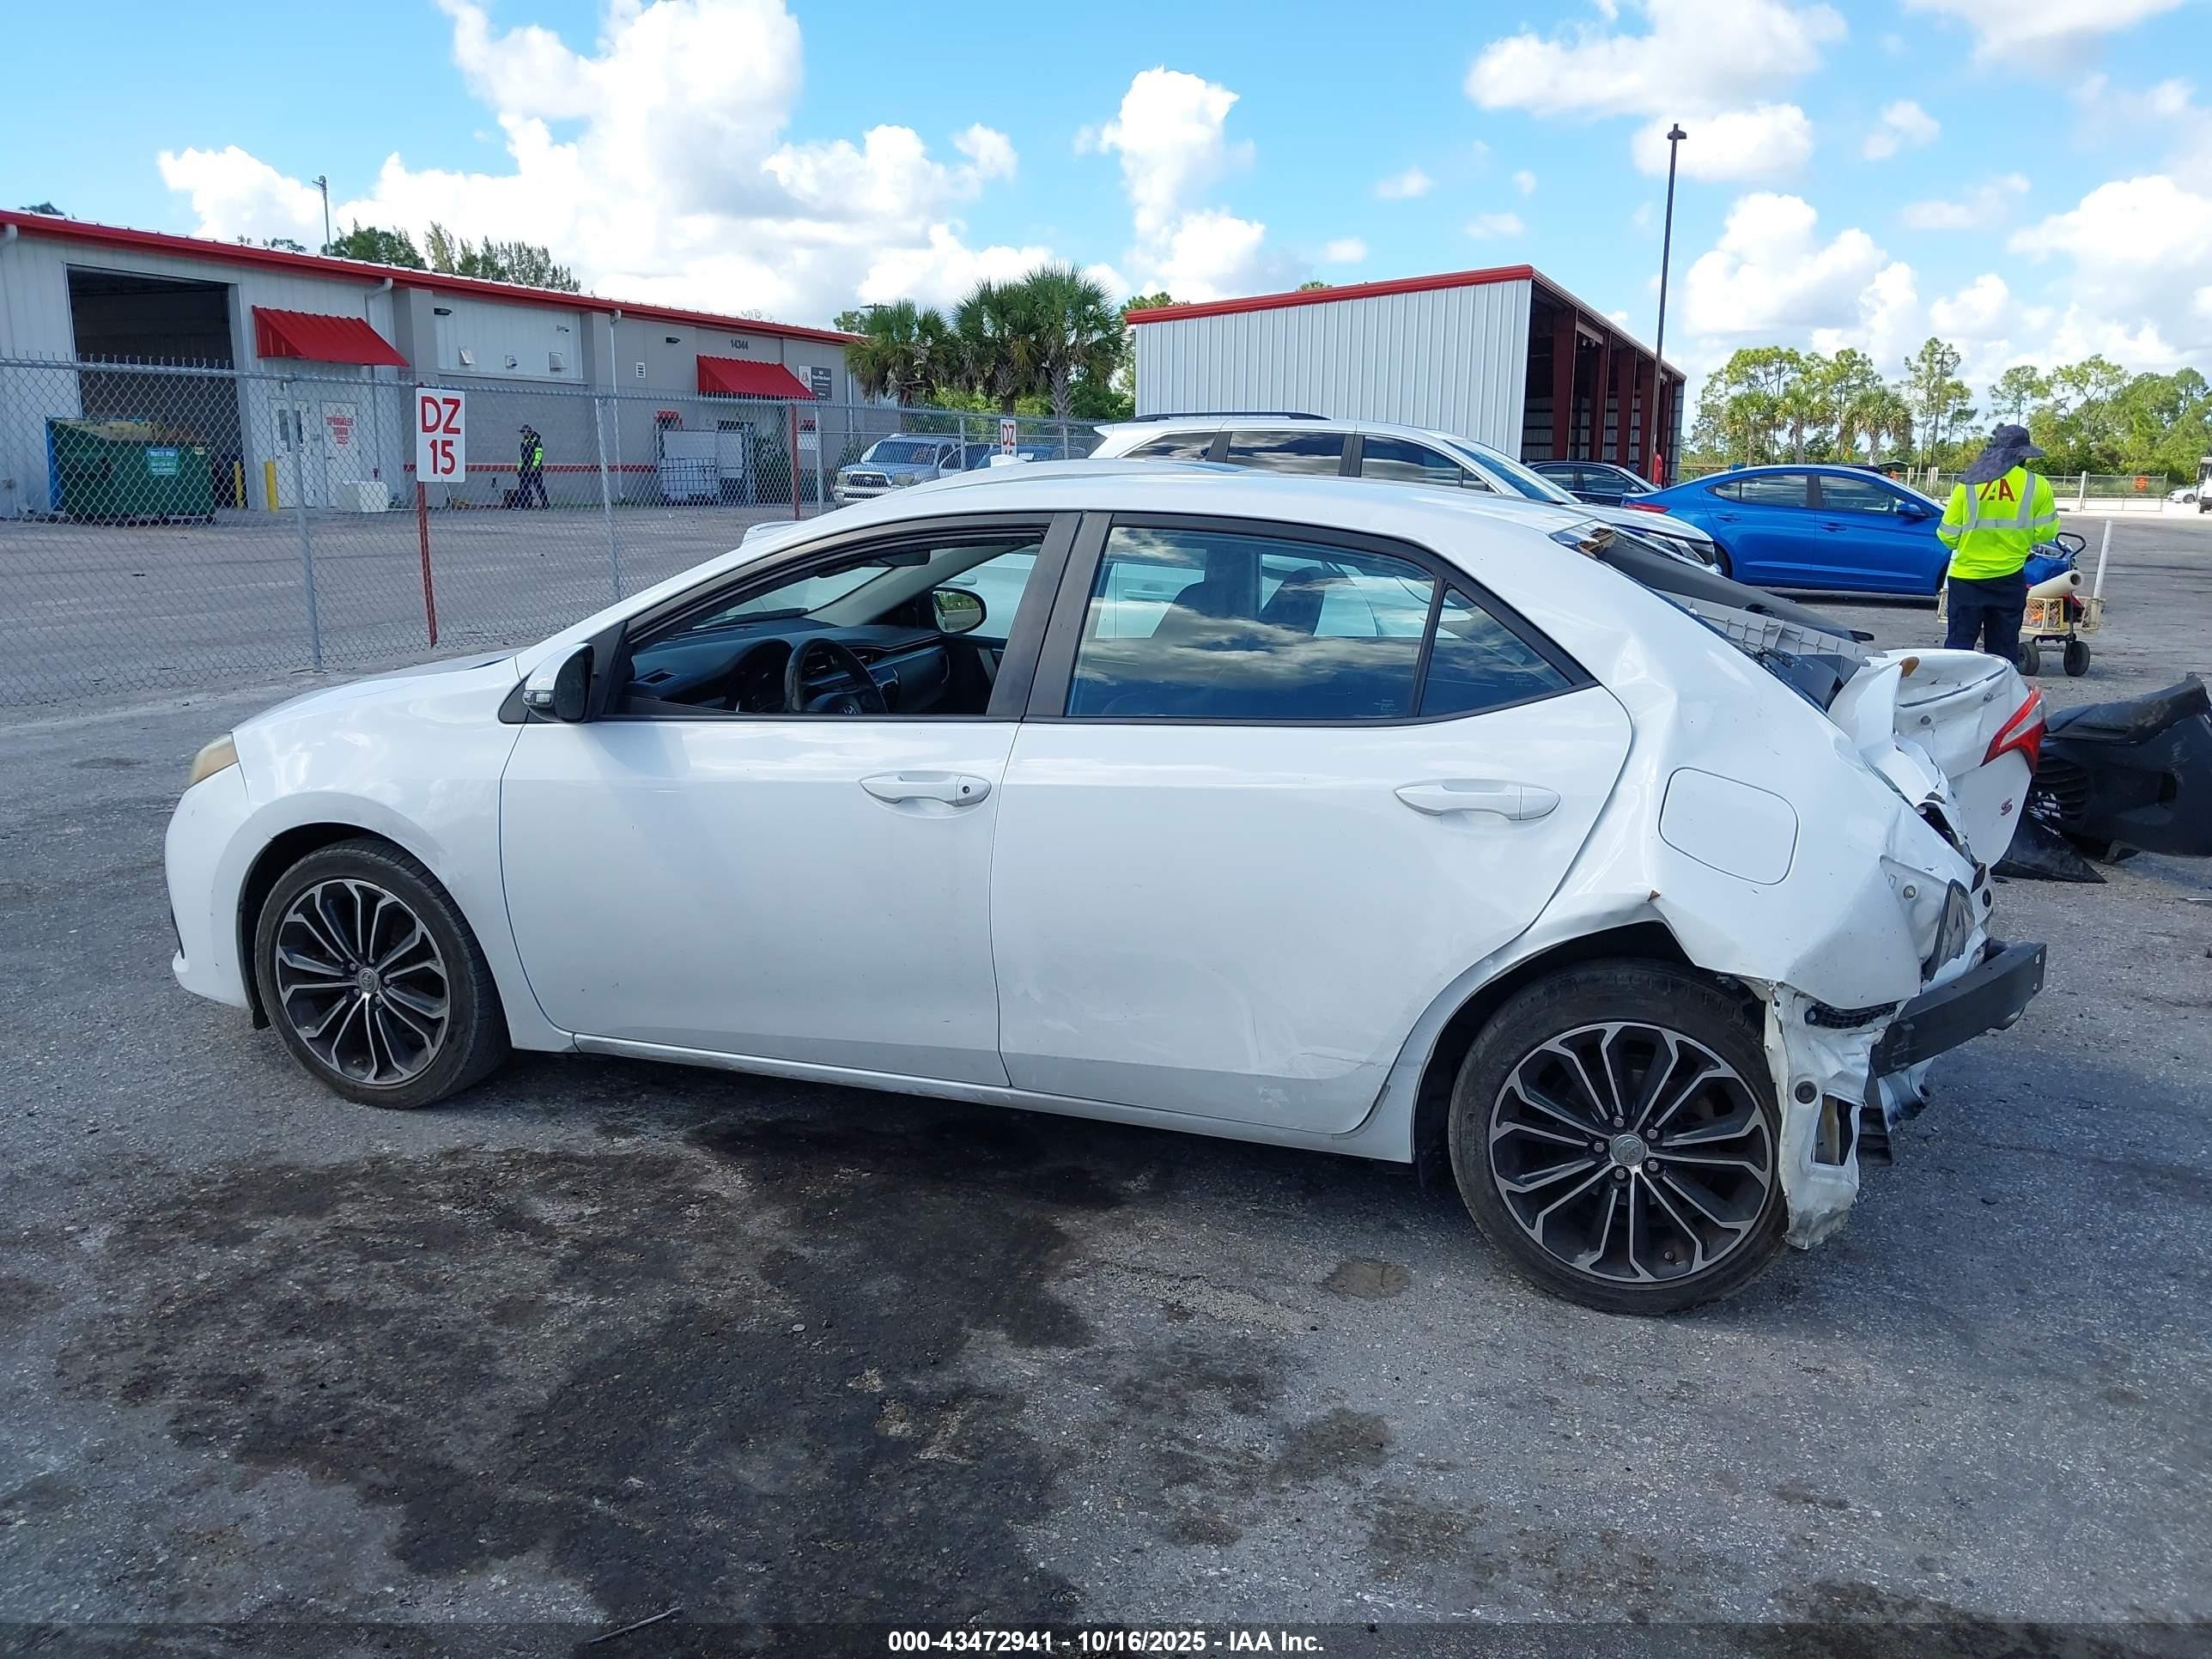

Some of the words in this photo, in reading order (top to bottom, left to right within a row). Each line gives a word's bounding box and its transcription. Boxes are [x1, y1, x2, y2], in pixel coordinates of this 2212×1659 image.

[730, 339, 749, 350] 14344
[421, 396, 461, 434] DZ
[1002, 424, 1015, 447] DZ
[429, 439, 456, 475] 15
